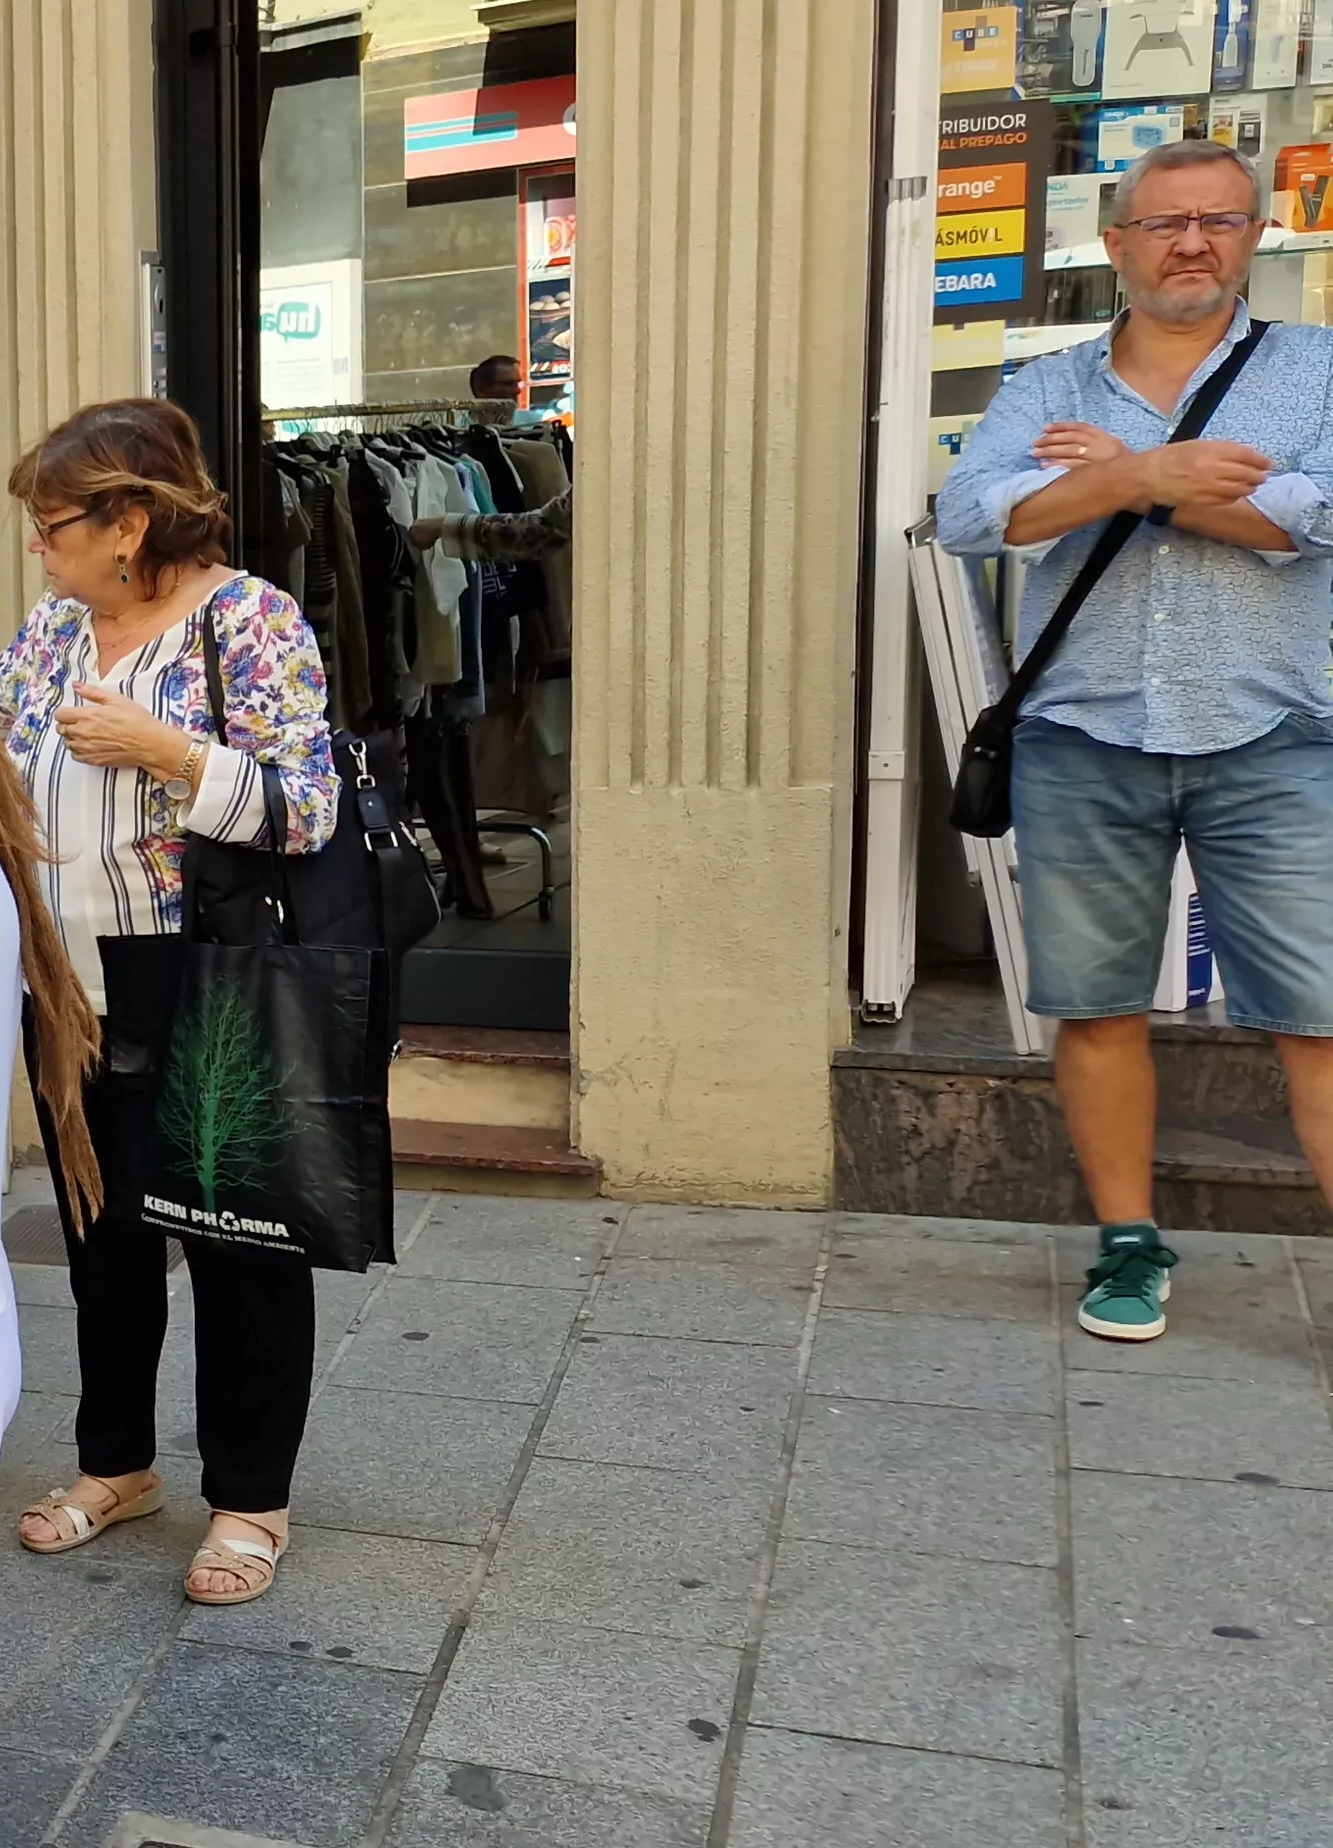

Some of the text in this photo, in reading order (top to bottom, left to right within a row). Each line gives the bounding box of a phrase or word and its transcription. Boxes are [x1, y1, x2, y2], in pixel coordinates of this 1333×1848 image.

[959, 132, 1027, 148] PREPAGO
[935, 272, 997, 292] EBARA
[143, 1193, 188, 1220] KERN
